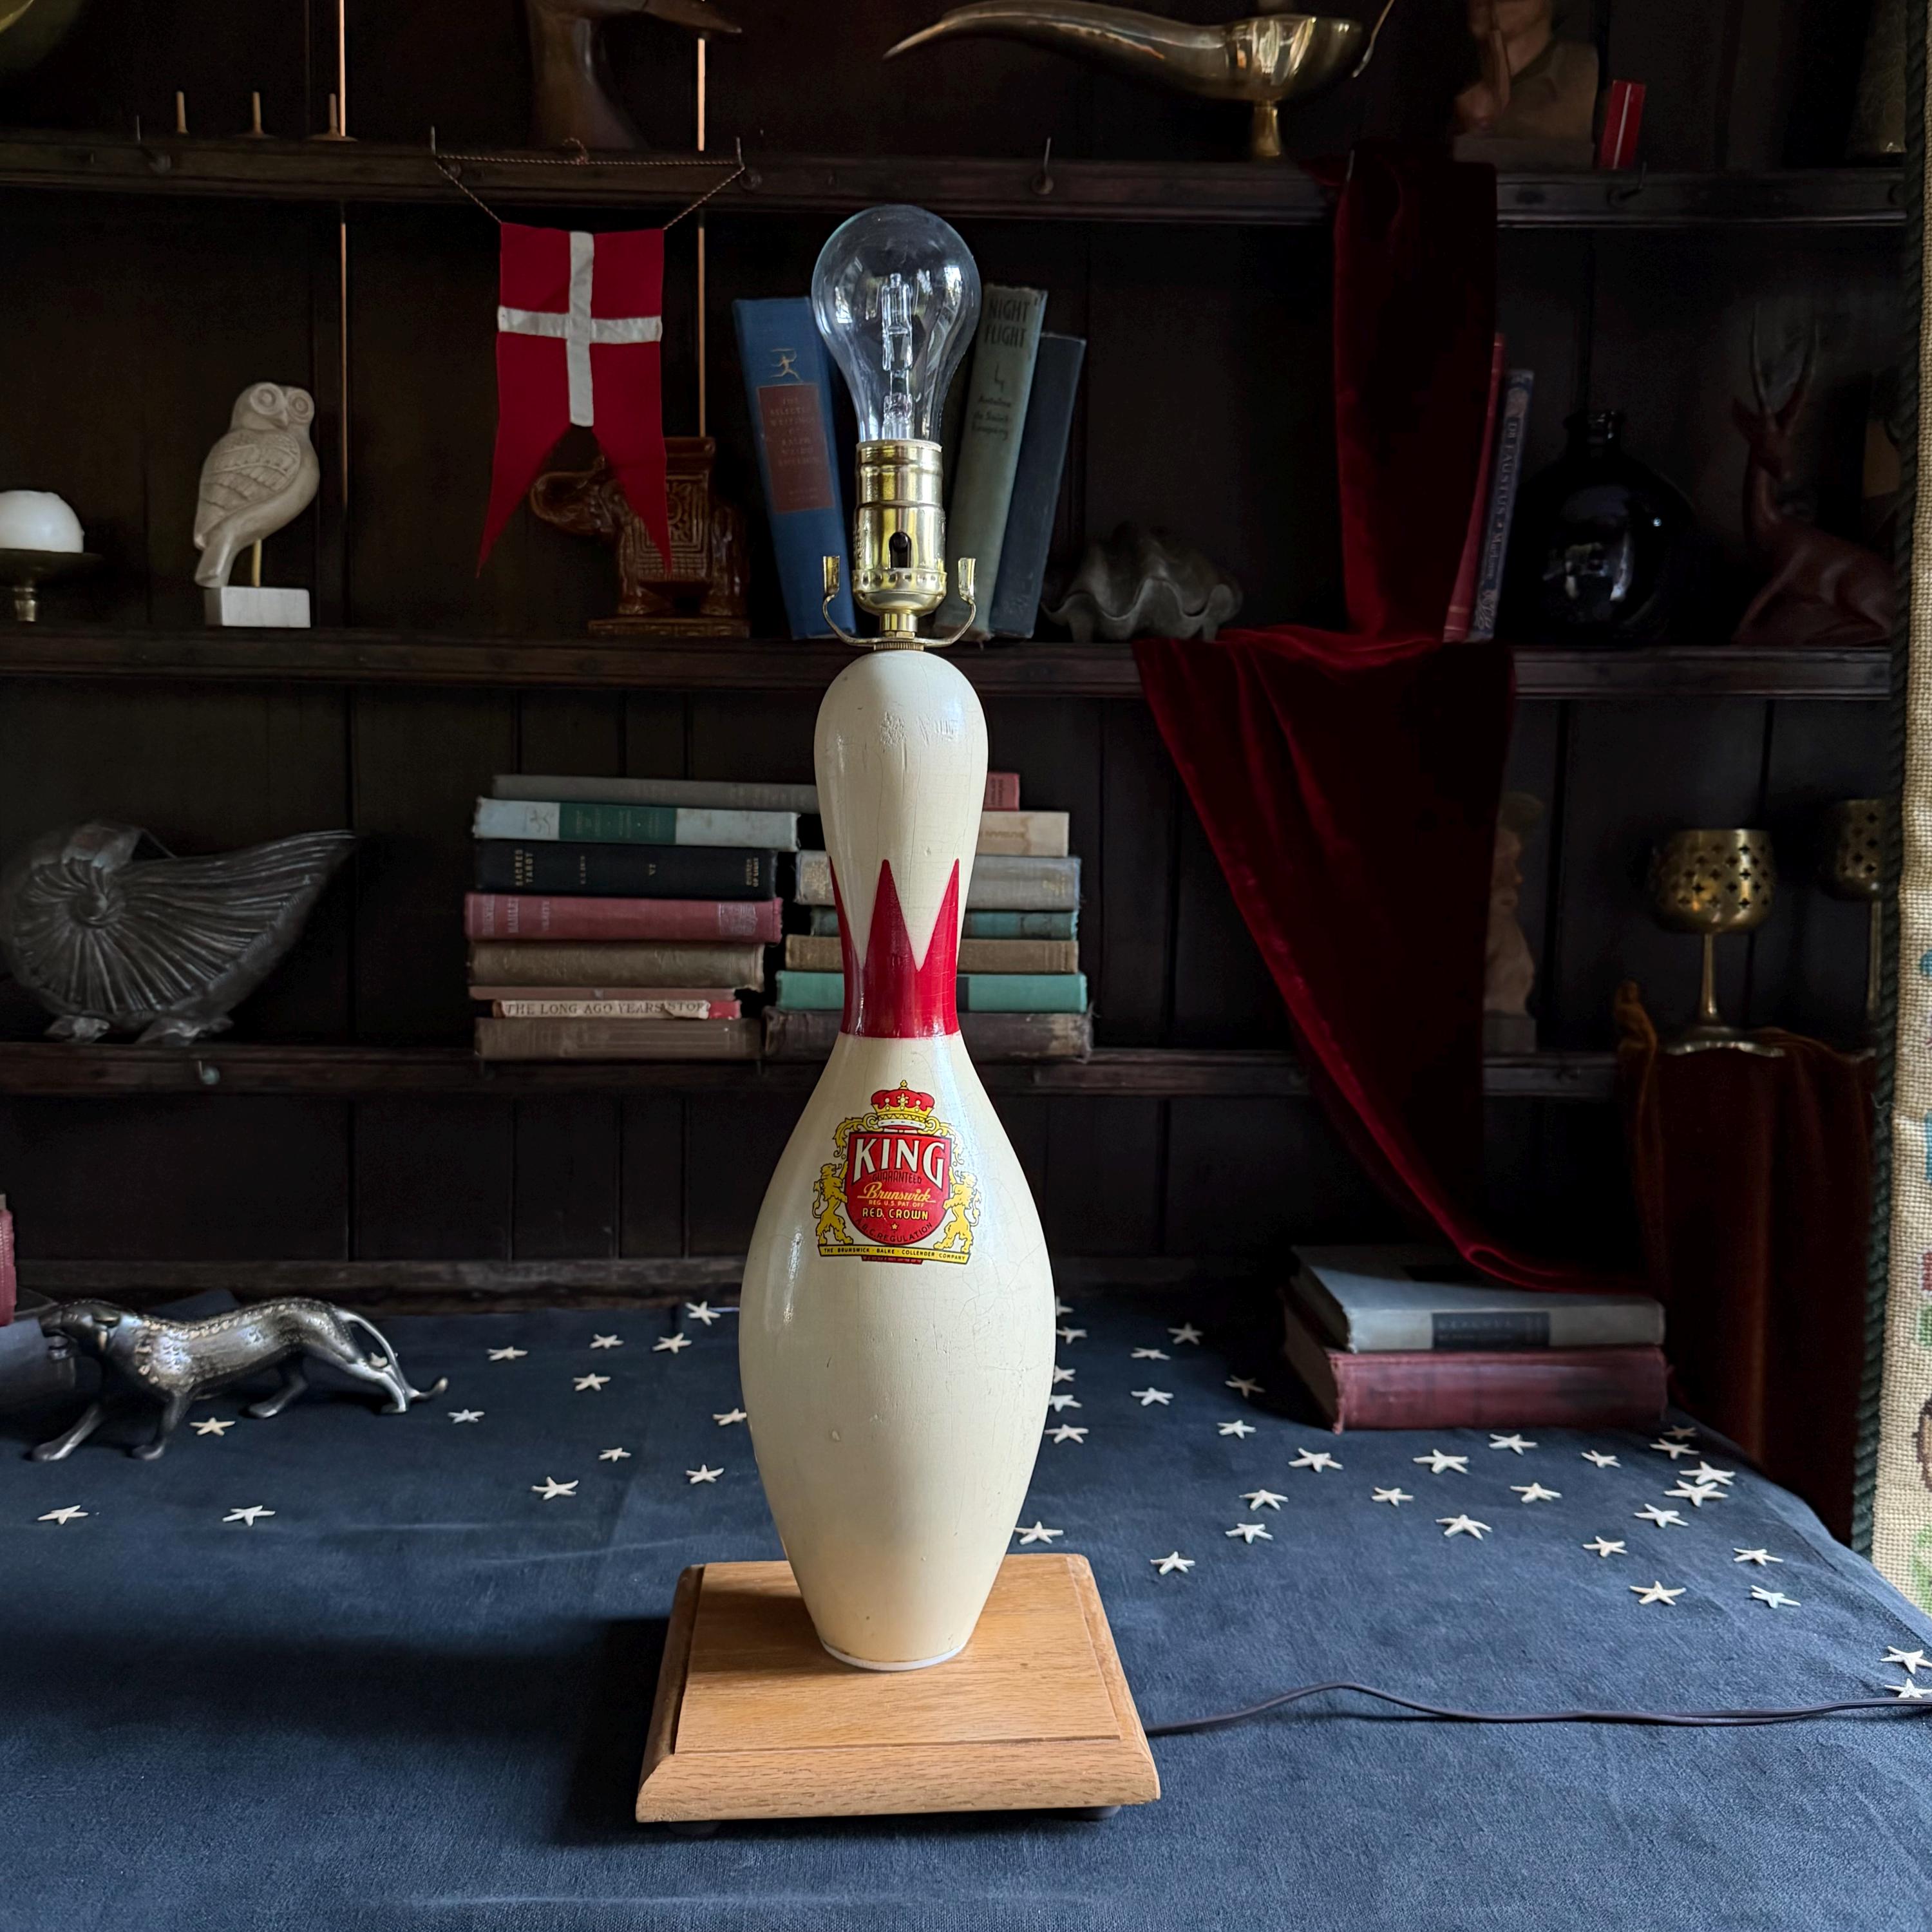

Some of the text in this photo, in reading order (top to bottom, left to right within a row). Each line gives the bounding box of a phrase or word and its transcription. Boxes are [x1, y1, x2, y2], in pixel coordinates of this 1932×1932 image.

[987, 298, 1030, 322] NIGHT
[984, 325, 1027, 348] FLIGHT
[514, 848, 524, 886] SACRED
[524, 851, 534, 883] TAROT
[505, 1003, 535, 1015] THE
[540, 1003, 578, 1015] LONG
[583, 1003, 612, 1015] AGO
[617, 1003, 662, 1014] YEARS
[852, 1137, 945, 1191] KING
[872, 1170, 922, 1184] GUARANTEED
[857, 1181, 936, 1203] Brunswick
[862, 1208, 929, 1221] RED CROWN
[876, 1222, 933, 1242] REGULATION
